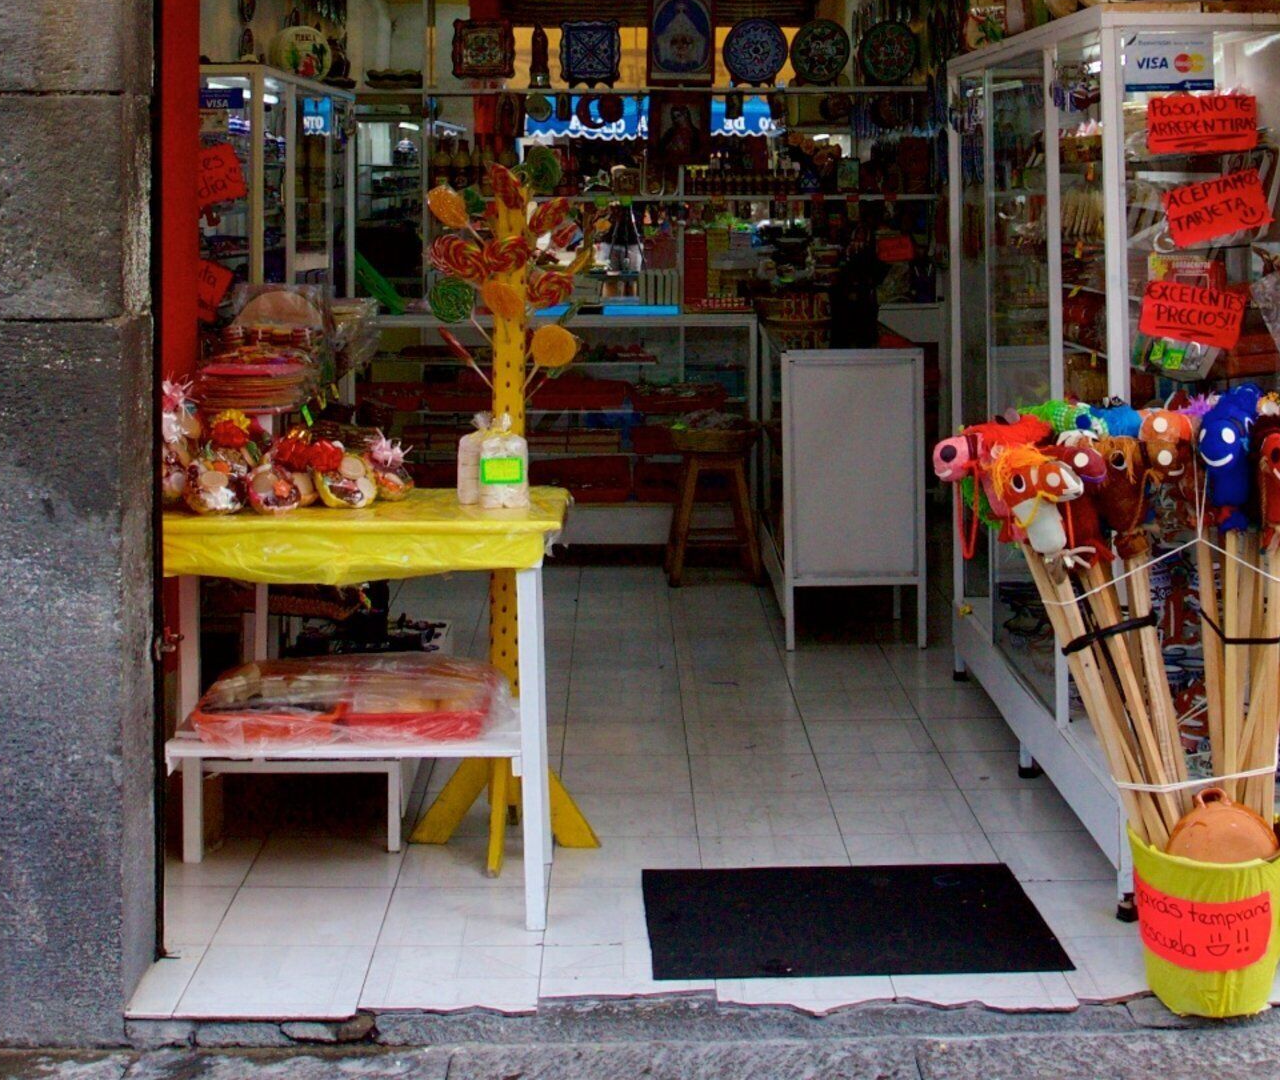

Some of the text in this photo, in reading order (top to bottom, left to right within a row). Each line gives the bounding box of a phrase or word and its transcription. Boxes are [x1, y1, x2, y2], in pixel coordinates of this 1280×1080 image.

[1136, 57, 1169, 70] VISA
[206, 98, 230, 108] VISA
[1232, 96, 1252, 111] TE
[1150, 117, 1257, 137] ARREPENTIRAS
[1167, 172, 1257, 210] ACEPTAMOS
[1171, 197, 1246, 231] TARJETA
[1147, 281, 1245, 311] EXCELENTES
[1188, 902, 1270, 930] temprano
